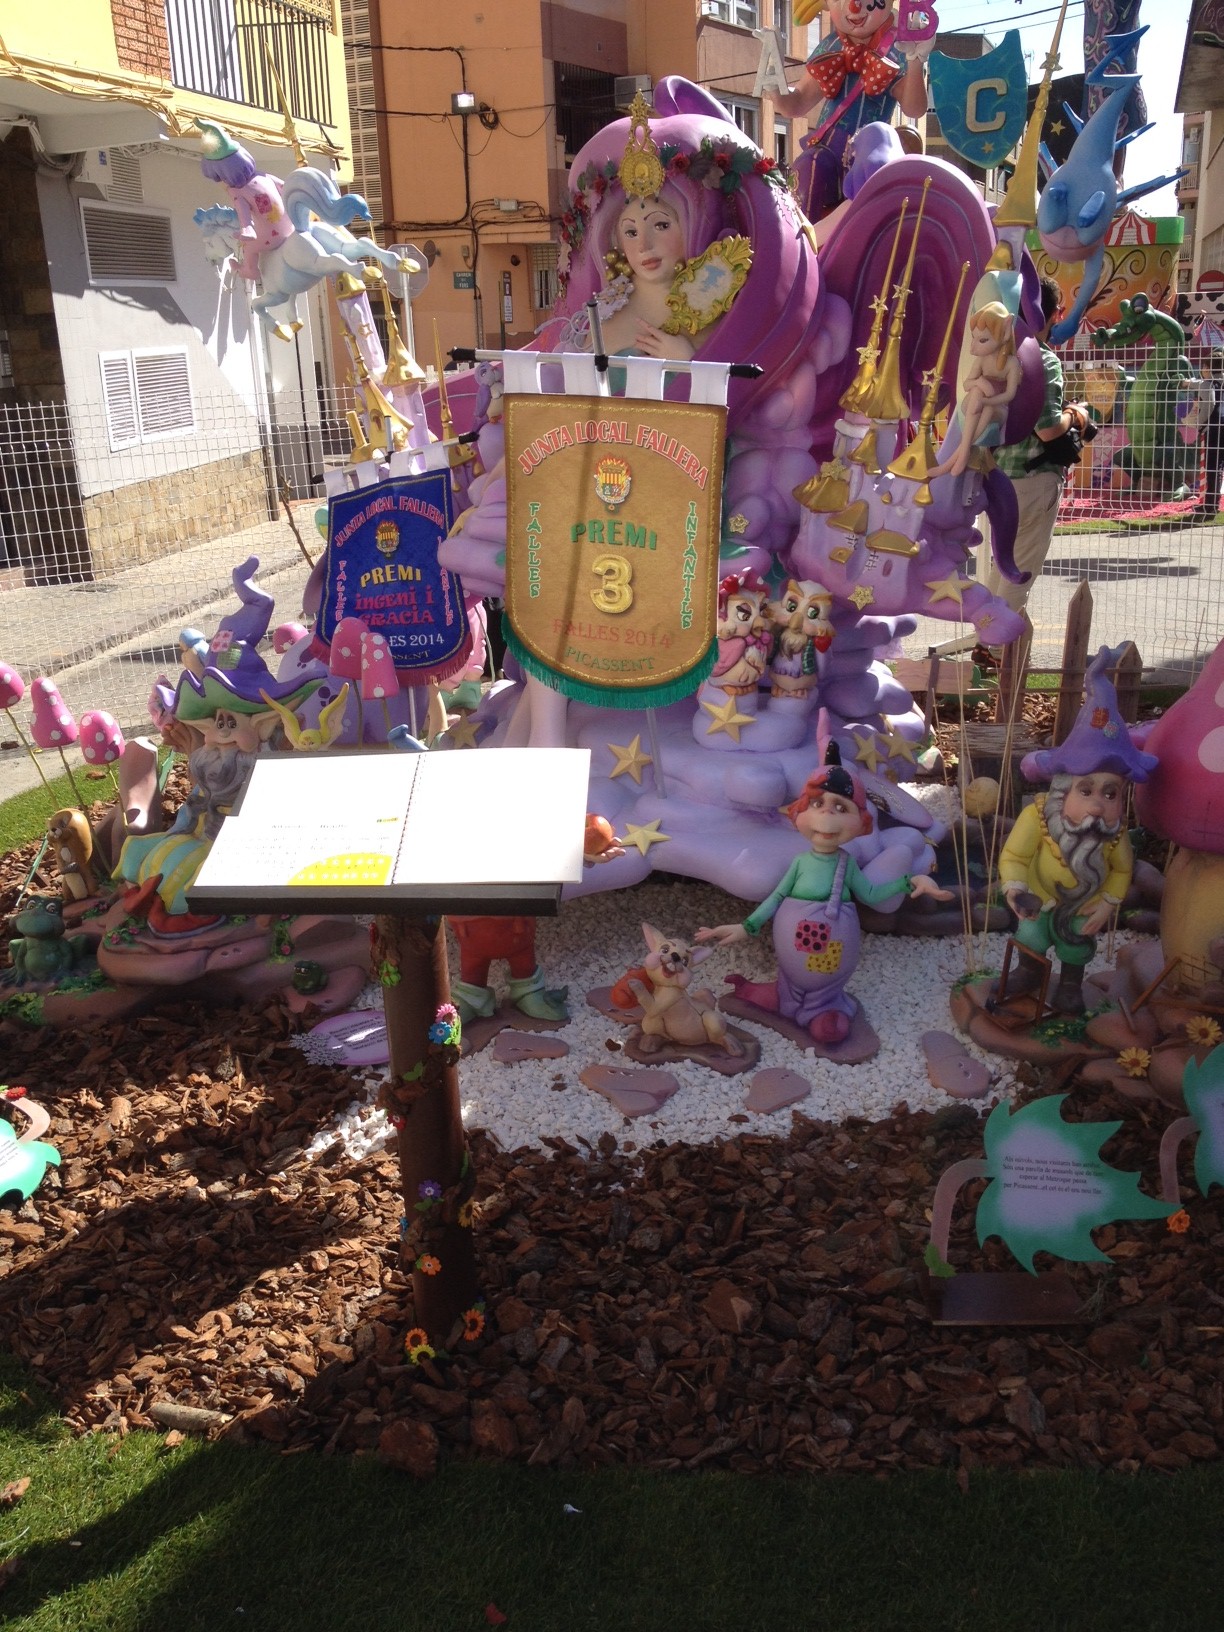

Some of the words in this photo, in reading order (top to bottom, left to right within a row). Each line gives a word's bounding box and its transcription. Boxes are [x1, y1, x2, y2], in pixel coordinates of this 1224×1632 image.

[752, 25, 790, 98] A
[965, 78, 1008, 133] C
[518, 425, 574, 475] JUNTA
[575, 420, 633, 444] LOCAL
[636, 424, 709, 490] FALLERA
[335, 511, 366, 547] JUNTA
[366, 495, 398, 519] LOCAL
[399, 496, 445, 529] FALLERA
[570, 519, 658, 550] PREMI
[360, 564, 422, 588] PREMI
[527, 502, 542, 598] FALLES
[680, 501, 698, 629] INFANTILS
[335, 560, 347, 622] FALLES
[425, 584, 434, 605] i
[437, 536, 454, 626] IANTILS
[590, 553, 633, 614] 3
[409, 633, 445, 647] 2014
[552, 618, 620, 642] FALLES
[624, 629, 673, 648] 2014
[565, 646, 656, 672] PICASSENT
